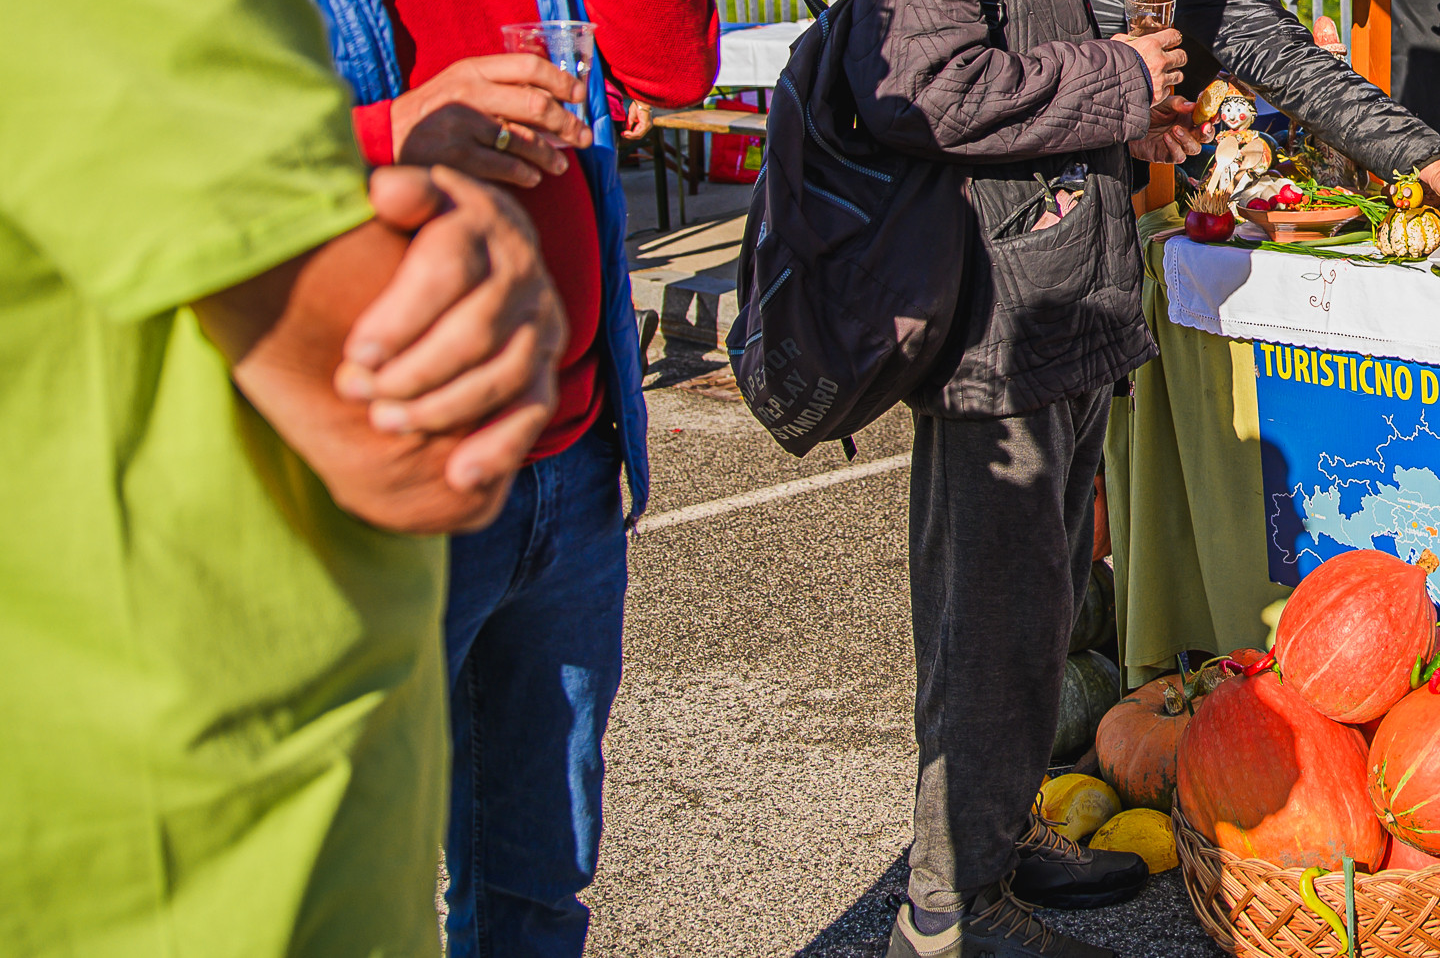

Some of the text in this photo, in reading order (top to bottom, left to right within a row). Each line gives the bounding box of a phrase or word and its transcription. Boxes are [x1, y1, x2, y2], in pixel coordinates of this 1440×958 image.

[757, 368, 808, 424] REPLAY
[1260, 343, 1412, 401] TURISTIČNO
[770, 377, 839, 440] STANDARD
